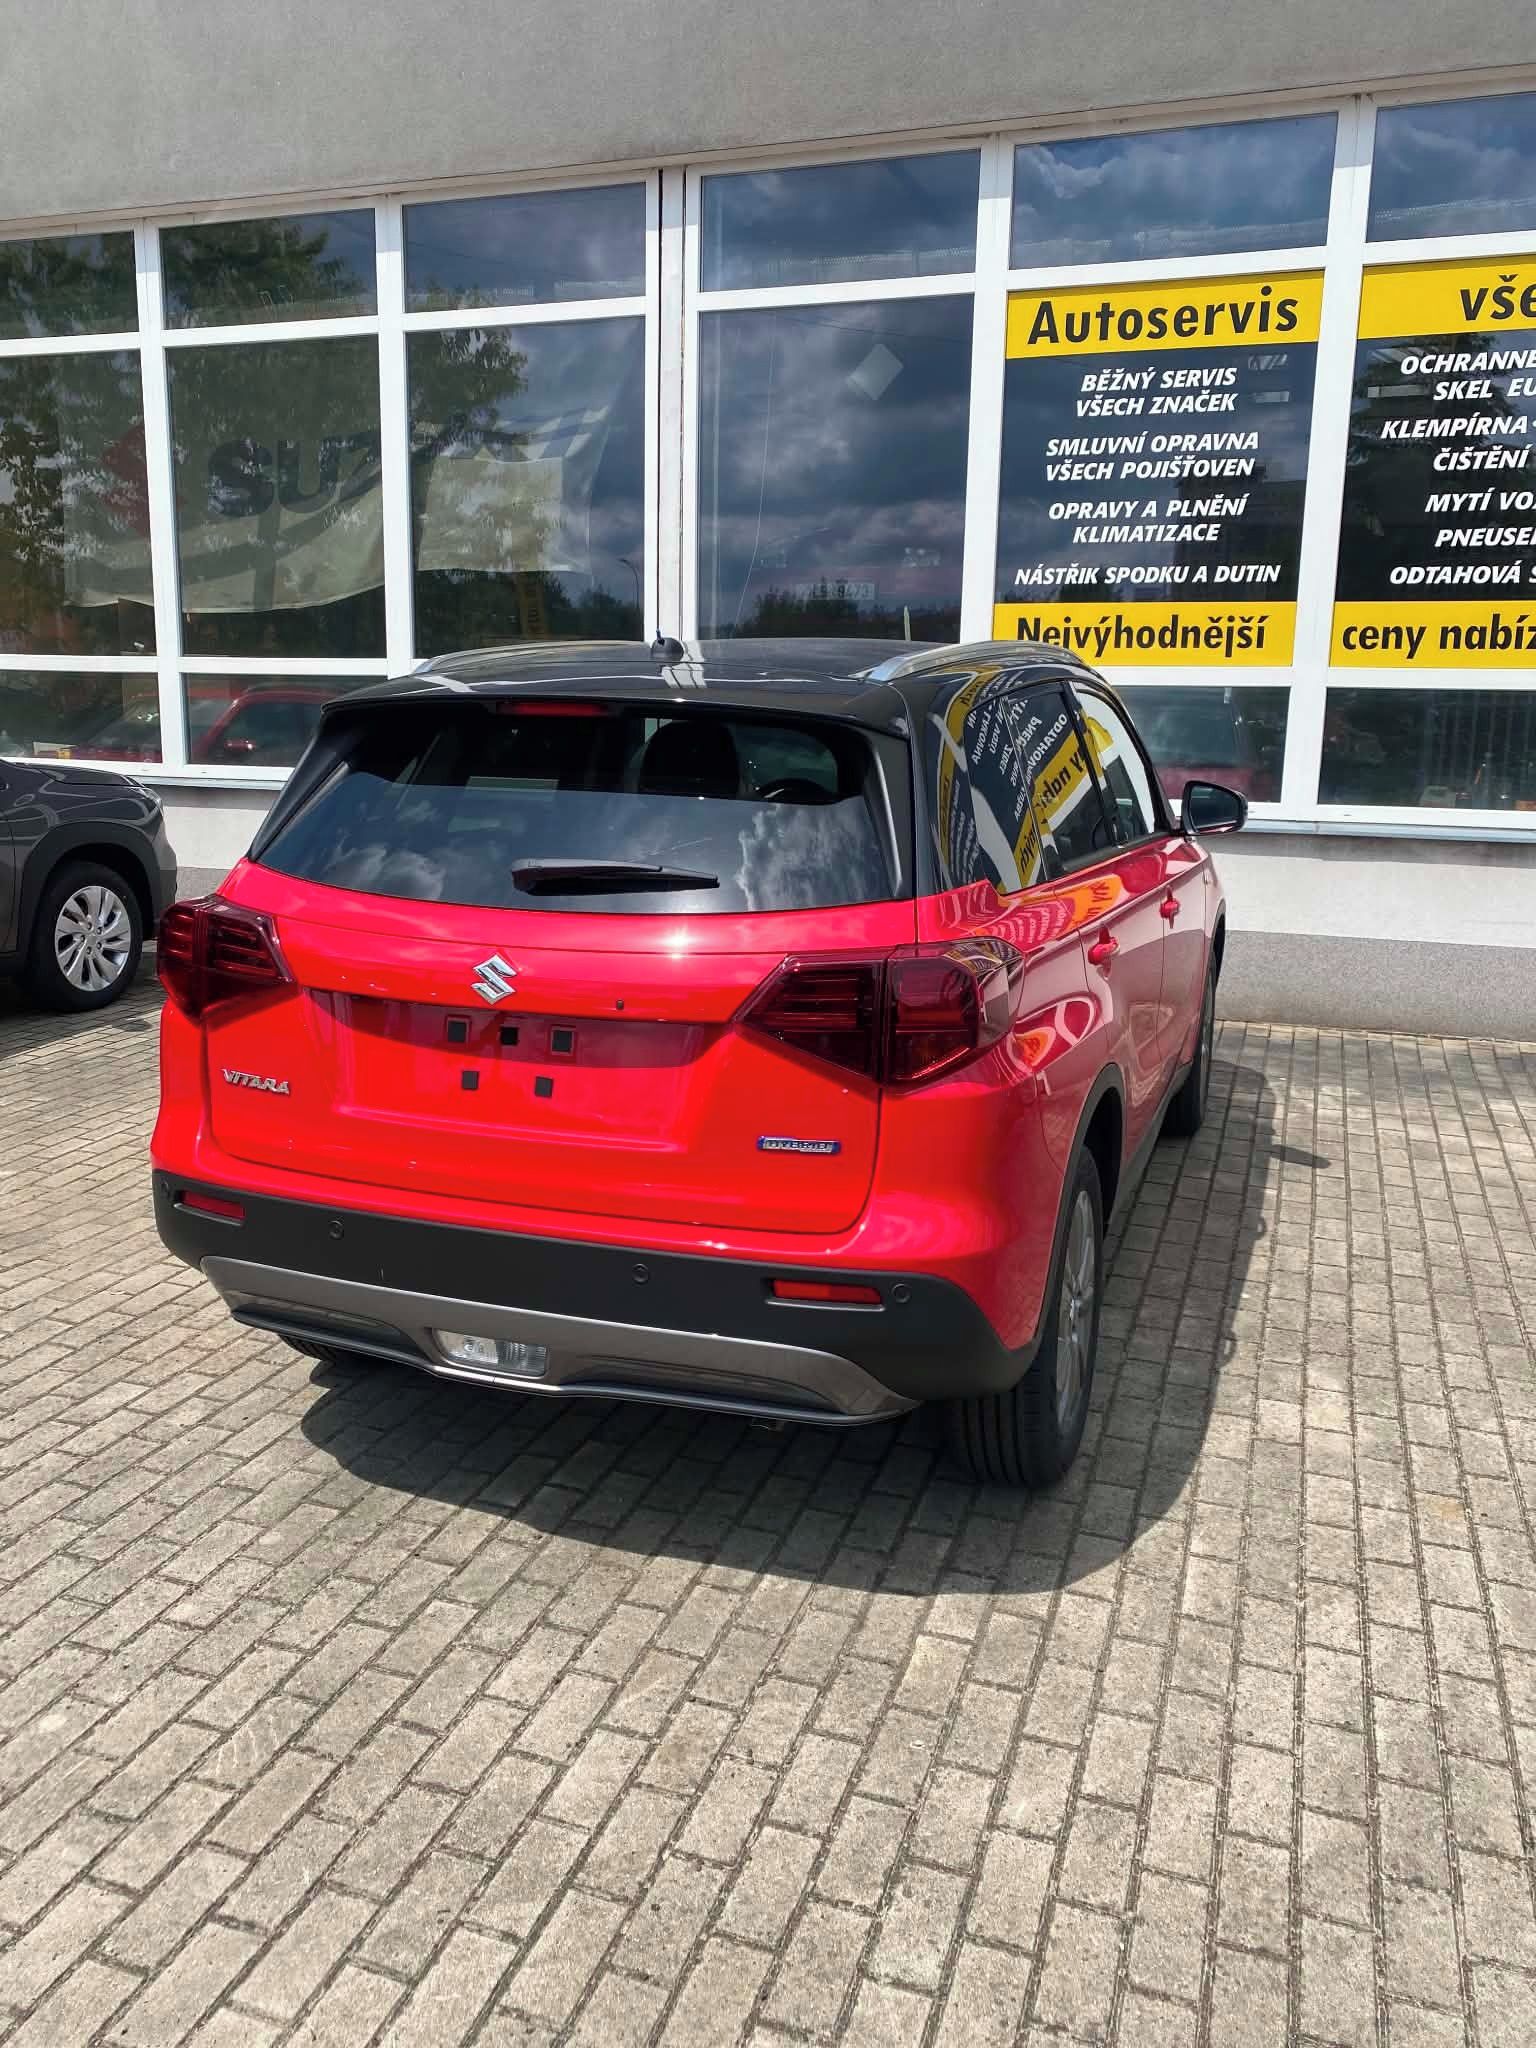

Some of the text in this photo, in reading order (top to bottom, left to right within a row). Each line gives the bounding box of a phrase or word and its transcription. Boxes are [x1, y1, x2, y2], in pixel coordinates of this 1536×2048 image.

[1027, 285, 1300, 345] Autoservis
[1080, 366, 1238, 392] BĚŽNÝ SERVIS
[1433, 379, 1493, 401] SKEL
[1076, 390, 1239, 417] VŠECH ZNAČEK
[1380, 412, 1528, 439] KLEMPÍRNA
[1046, 430, 1259, 457] SMLUVNÍ OPRAVNA
[1433, 443, 1530, 471] ČIŠTĚNÍ
[1046, 456, 1256, 481] VŠECH POJIŠŤOVEN
[1048, 492, 1250, 520] OPRAVY A PLNĚNÍ
[1424, 487, 1536, 513] MYTÍ VO
[1072, 523, 1221, 544] KLIMATIZACE
[1014, 562, 1281, 585] NÁSTŘIK SPODKU A DUTIN
[1390, 559, 1522, 585] ODTAHOVÁ
[1342, 625, 1427, 658] ceny
[221, 1068, 290, 1096] VITARA
